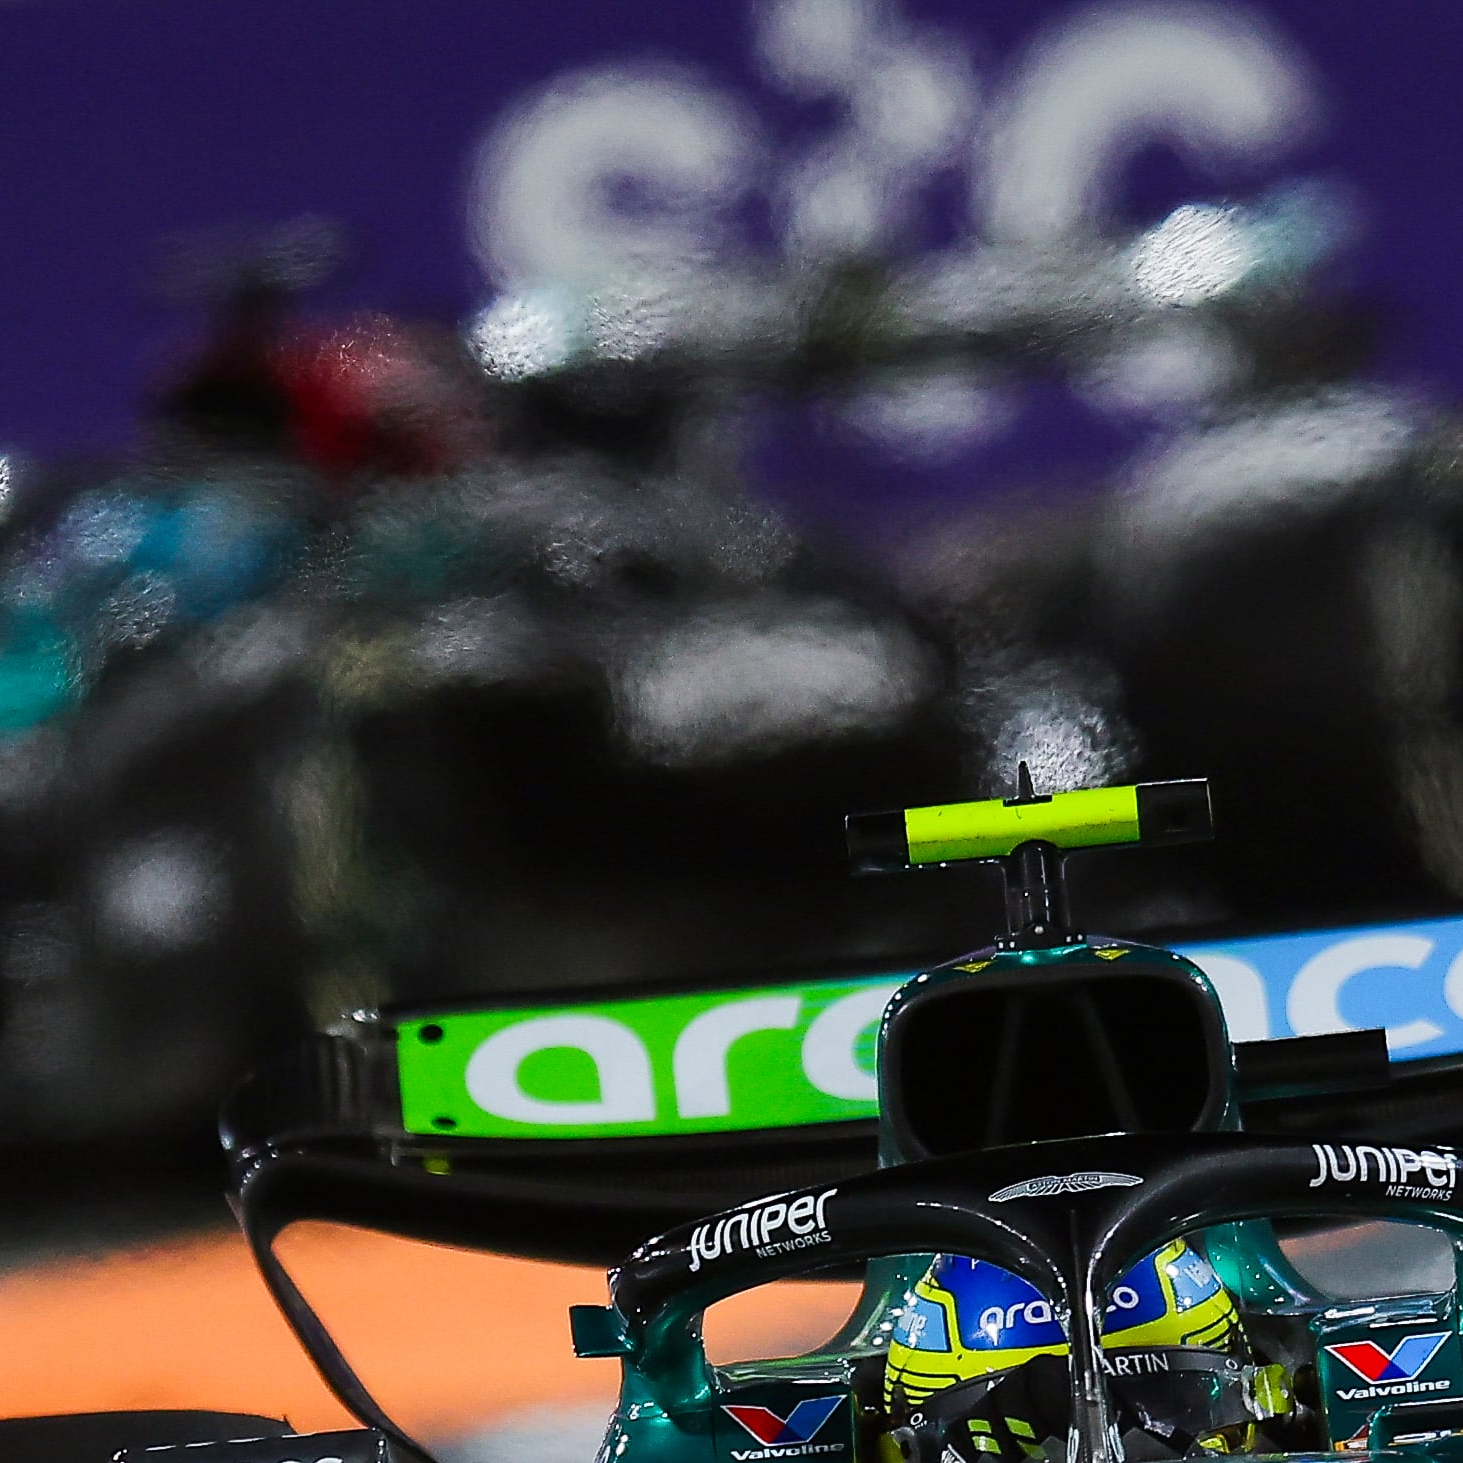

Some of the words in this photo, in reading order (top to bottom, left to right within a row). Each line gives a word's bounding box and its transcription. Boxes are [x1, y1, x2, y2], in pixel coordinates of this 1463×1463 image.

[1386, 1185, 1453, 1201] NETWORKS
[755, 1230, 832, 1259] NETWORKS
[979, 1285, 1139, 1331] arao
[1099, 1352, 1170, 1378] ARTIN
[1336, 1380, 1451, 1401] Valvoline
[730, 1443, 845, 1462] Valvoline
